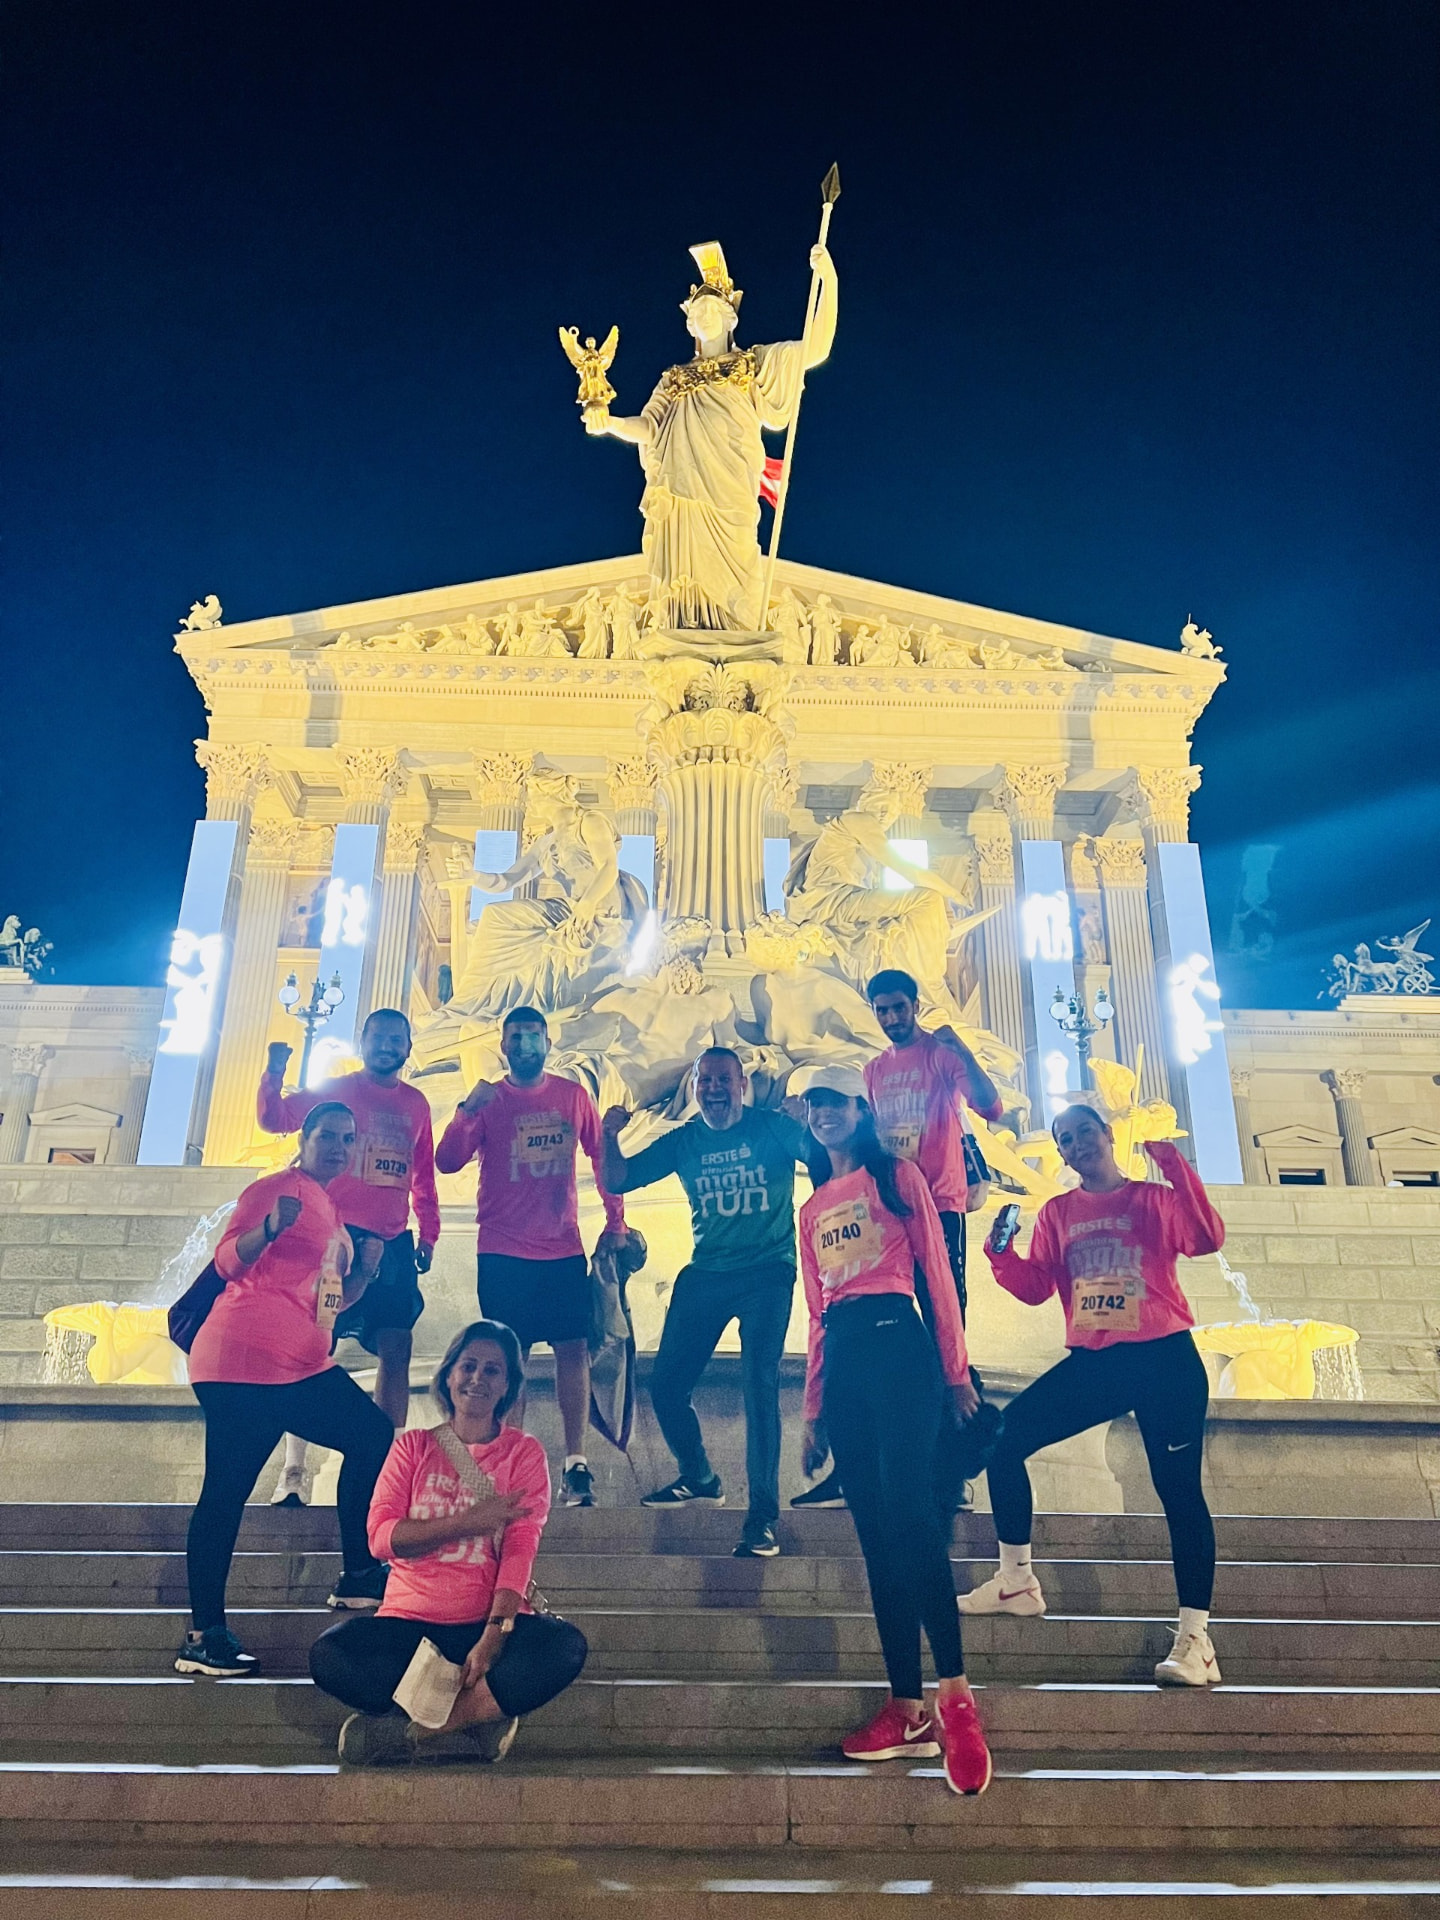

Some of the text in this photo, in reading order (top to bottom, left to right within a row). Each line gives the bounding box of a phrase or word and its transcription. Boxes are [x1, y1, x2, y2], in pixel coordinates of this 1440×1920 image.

[527, 1133, 563, 1147] 20743
[701, 1149, 738, 1165] ERSTE
[695, 1165, 768, 1196] night
[698, 1186, 770, 1218] run
[821, 1222, 861, 1249] 20740
[1069, 1217, 1113, 1237] ERSTE
[324, 1293, 342, 1309] 207
[1081, 1295, 1125, 1310] 20742
